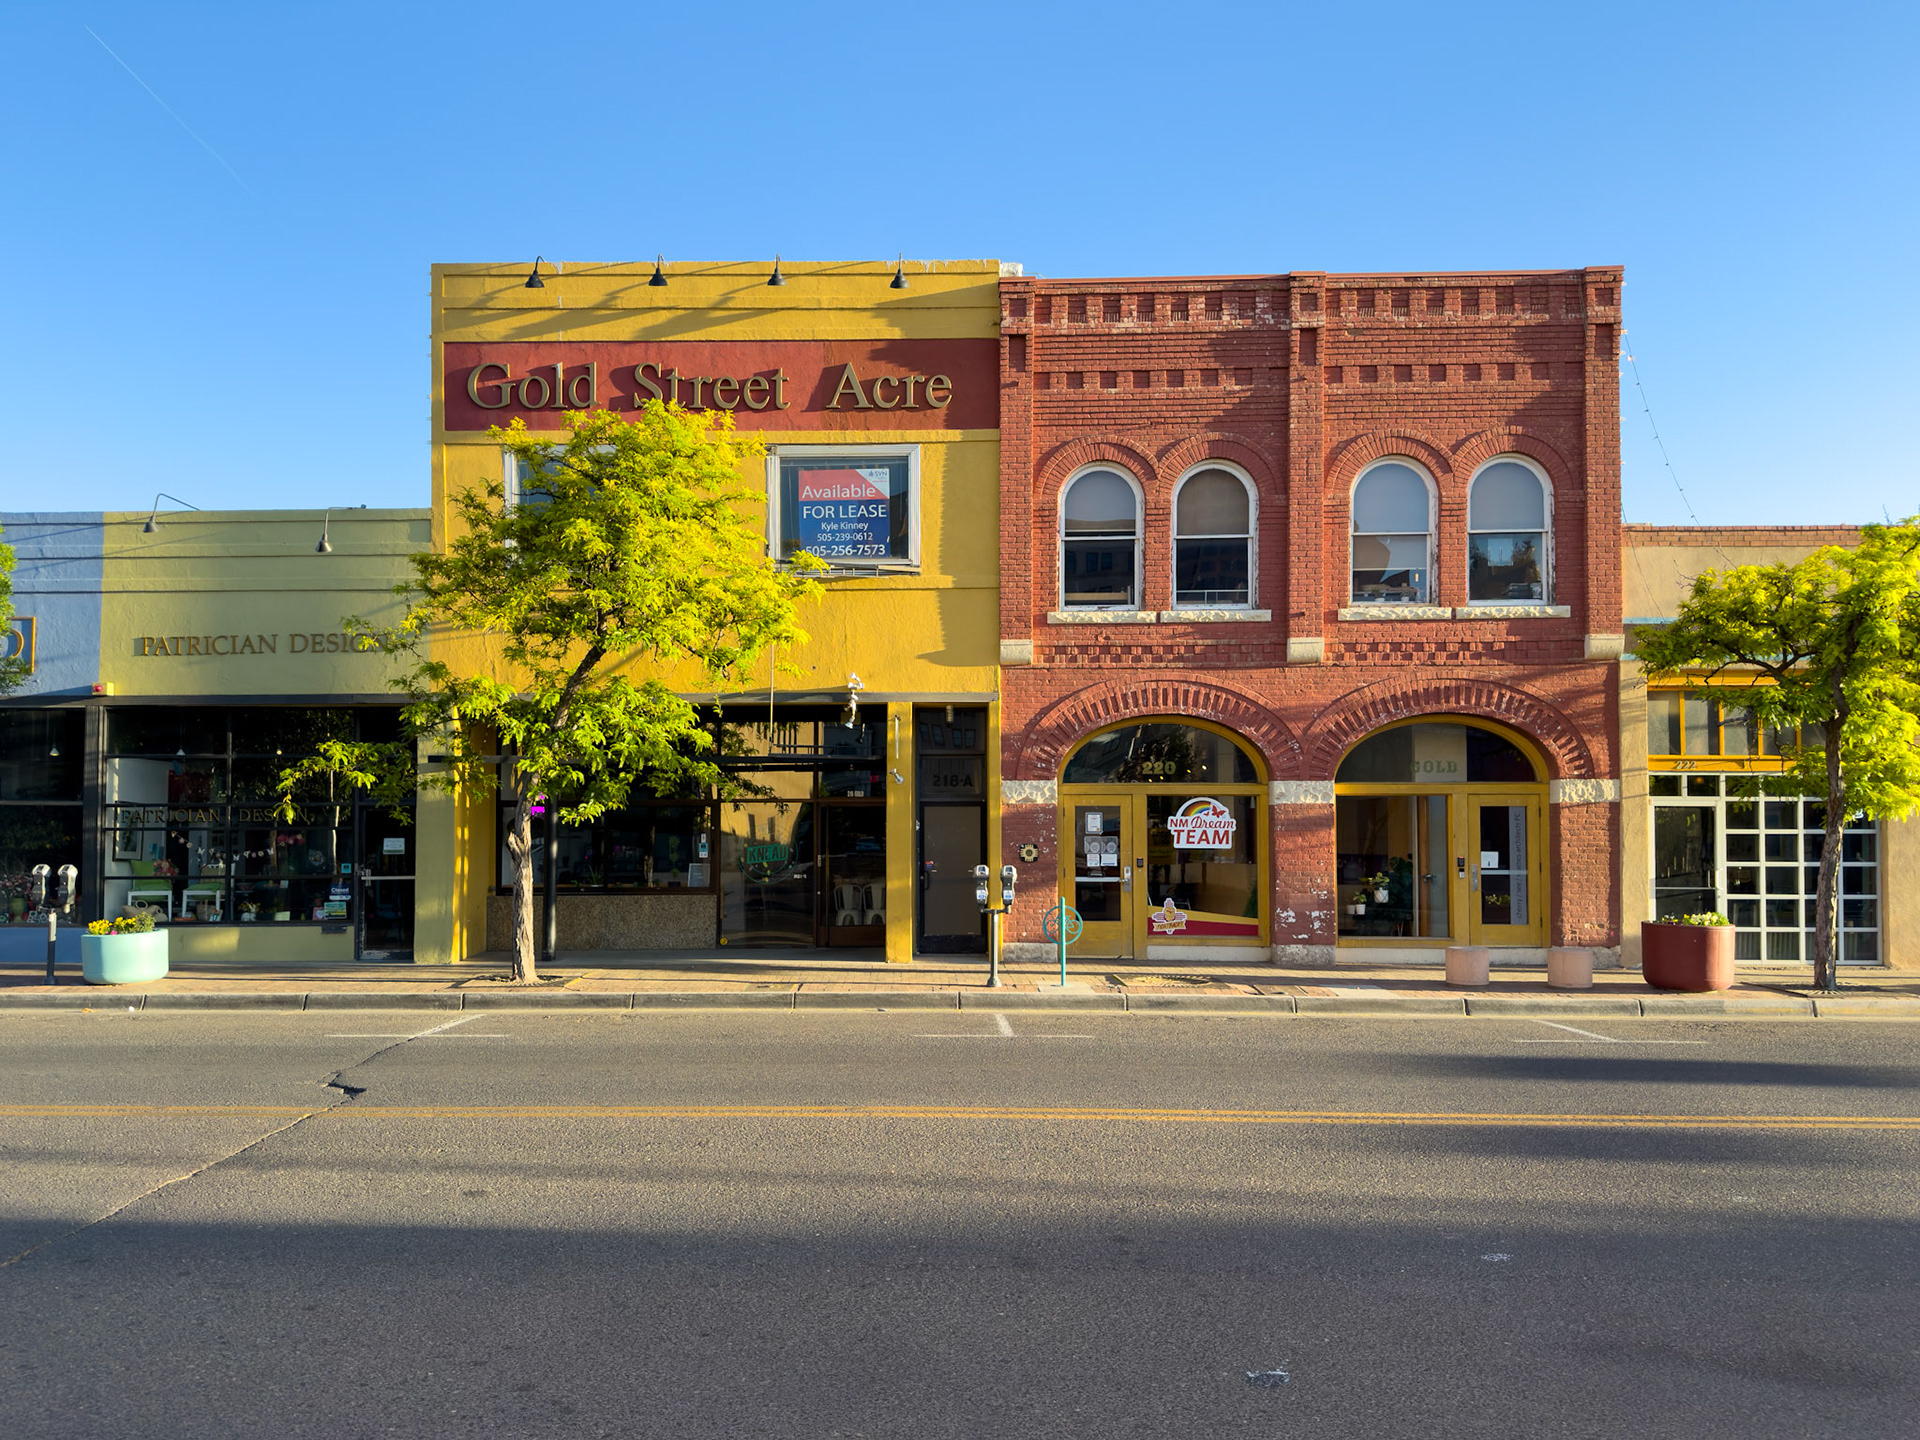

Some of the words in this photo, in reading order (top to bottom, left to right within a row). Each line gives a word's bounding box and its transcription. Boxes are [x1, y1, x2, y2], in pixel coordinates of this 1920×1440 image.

[467, 362, 601, 409] Gold
[633, 362, 791, 409] Street
[825, 362, 953, 408] Acre
[802, 484, 876, 499] Available
[803, 505, 835, 518] FOR
[839, 504, 887, 518] LEASE
[821, 522, 839, 532] Kyle
[840, 522, 869, 531] Kinney
[817, 532, 873, 541] 505-239-0612
[141, 634, 278, 656] PATRICIAN
[1142, 761, 1176, 775] 220
[1410, 760, 1458, 773] GOLD
[1676, 760, 1697, 770] 222
[121, 809, 221, 823] PATRICIAN
[1170, 818, 1189, 828] NM
[1191, 815, 1234, 829] Dream
[1173, 829, 1230, 845] TEAM
